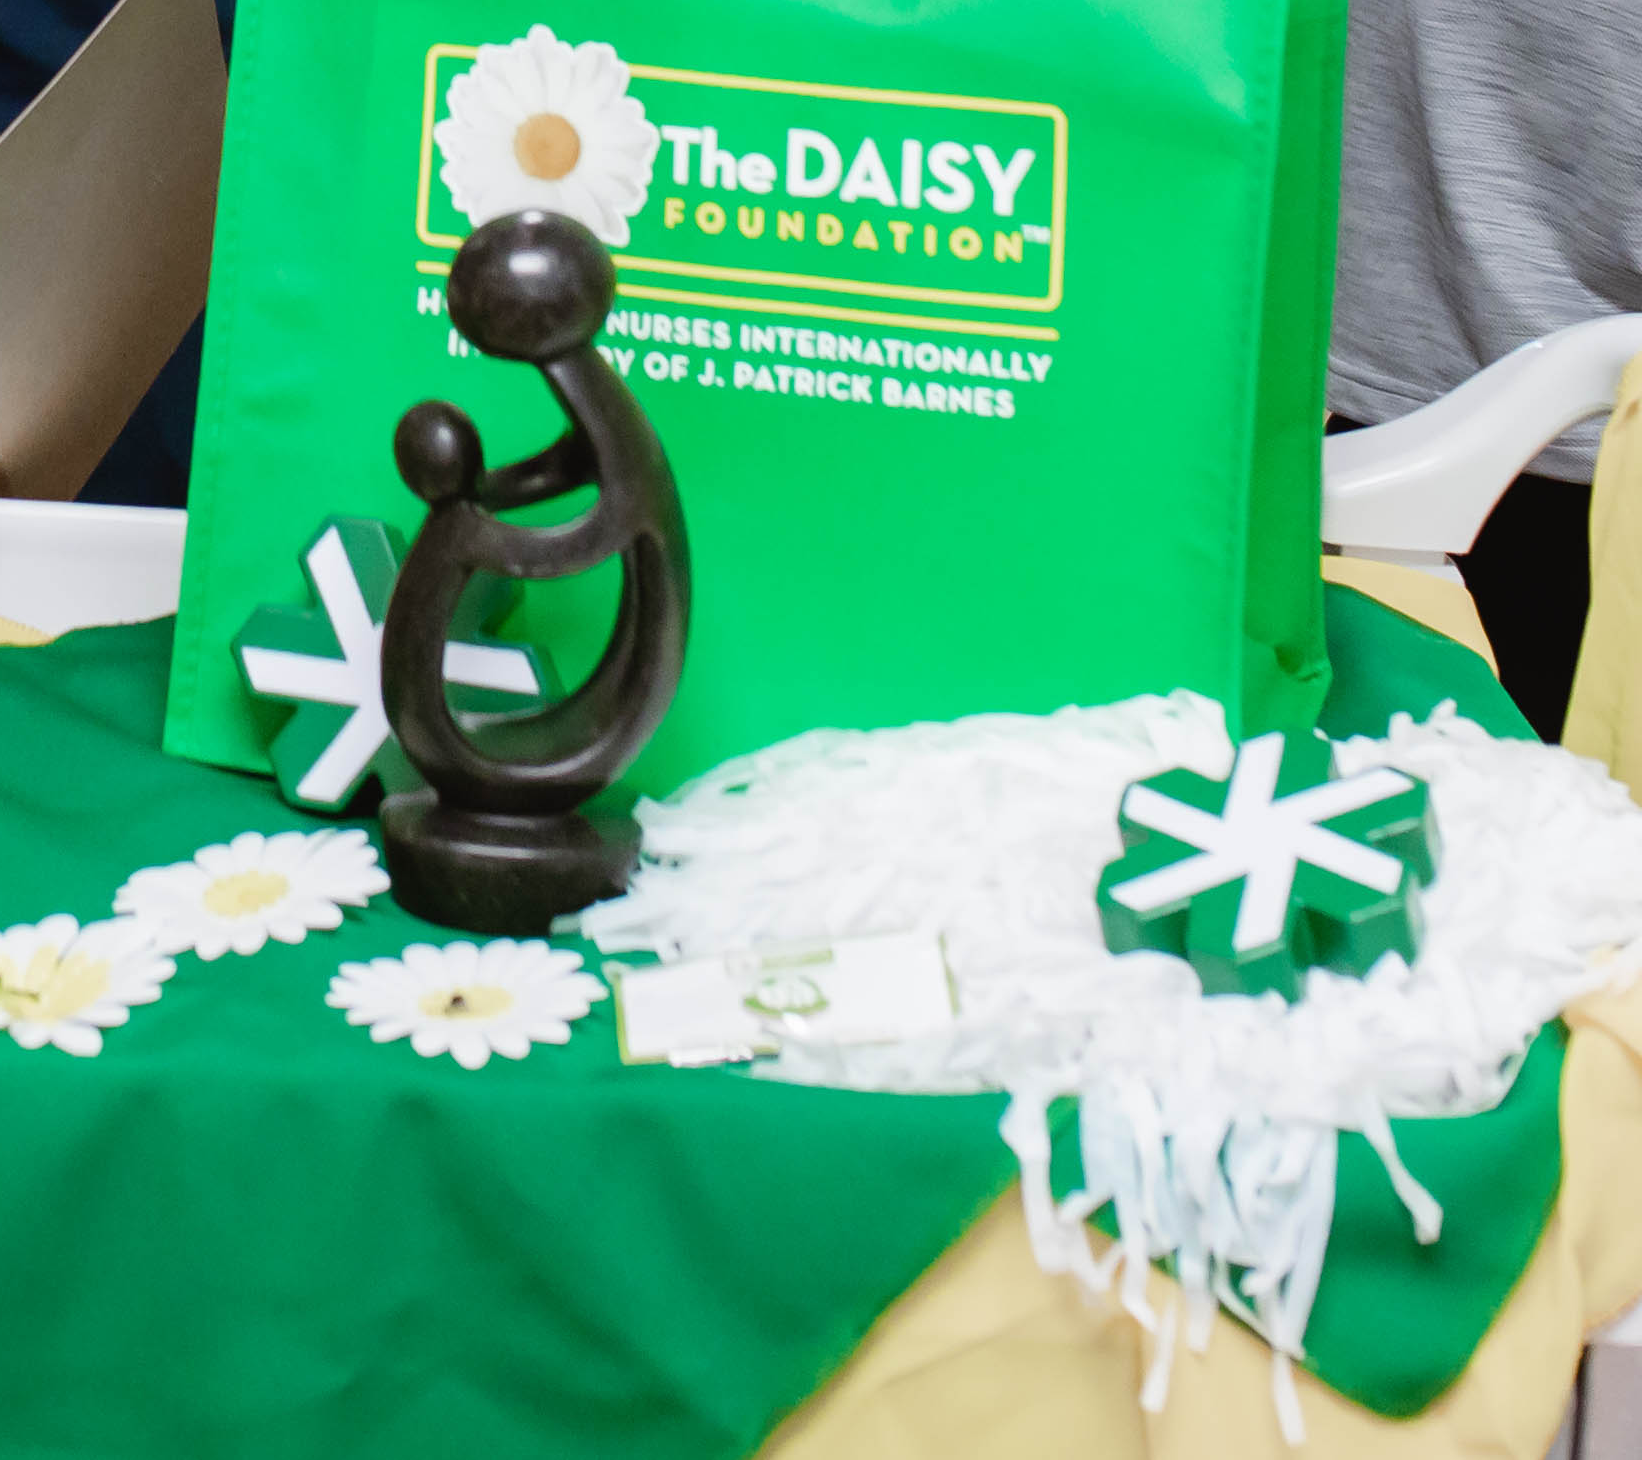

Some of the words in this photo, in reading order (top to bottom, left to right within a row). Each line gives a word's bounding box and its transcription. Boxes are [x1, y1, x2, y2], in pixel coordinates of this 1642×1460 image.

[661, 125, 777, 194] The
[786, 128, 1036, 217] DAISY
[606, 310, 732, 350] NURSES
[740, 324, 1053, 383] INTERNATIONALLY
[643, 351, 690, 383] OF
[697, 357, 726, 389] J.
[733, 361, 873, 405] PATRICK
[882, 378, 1016, 419] BARNES
